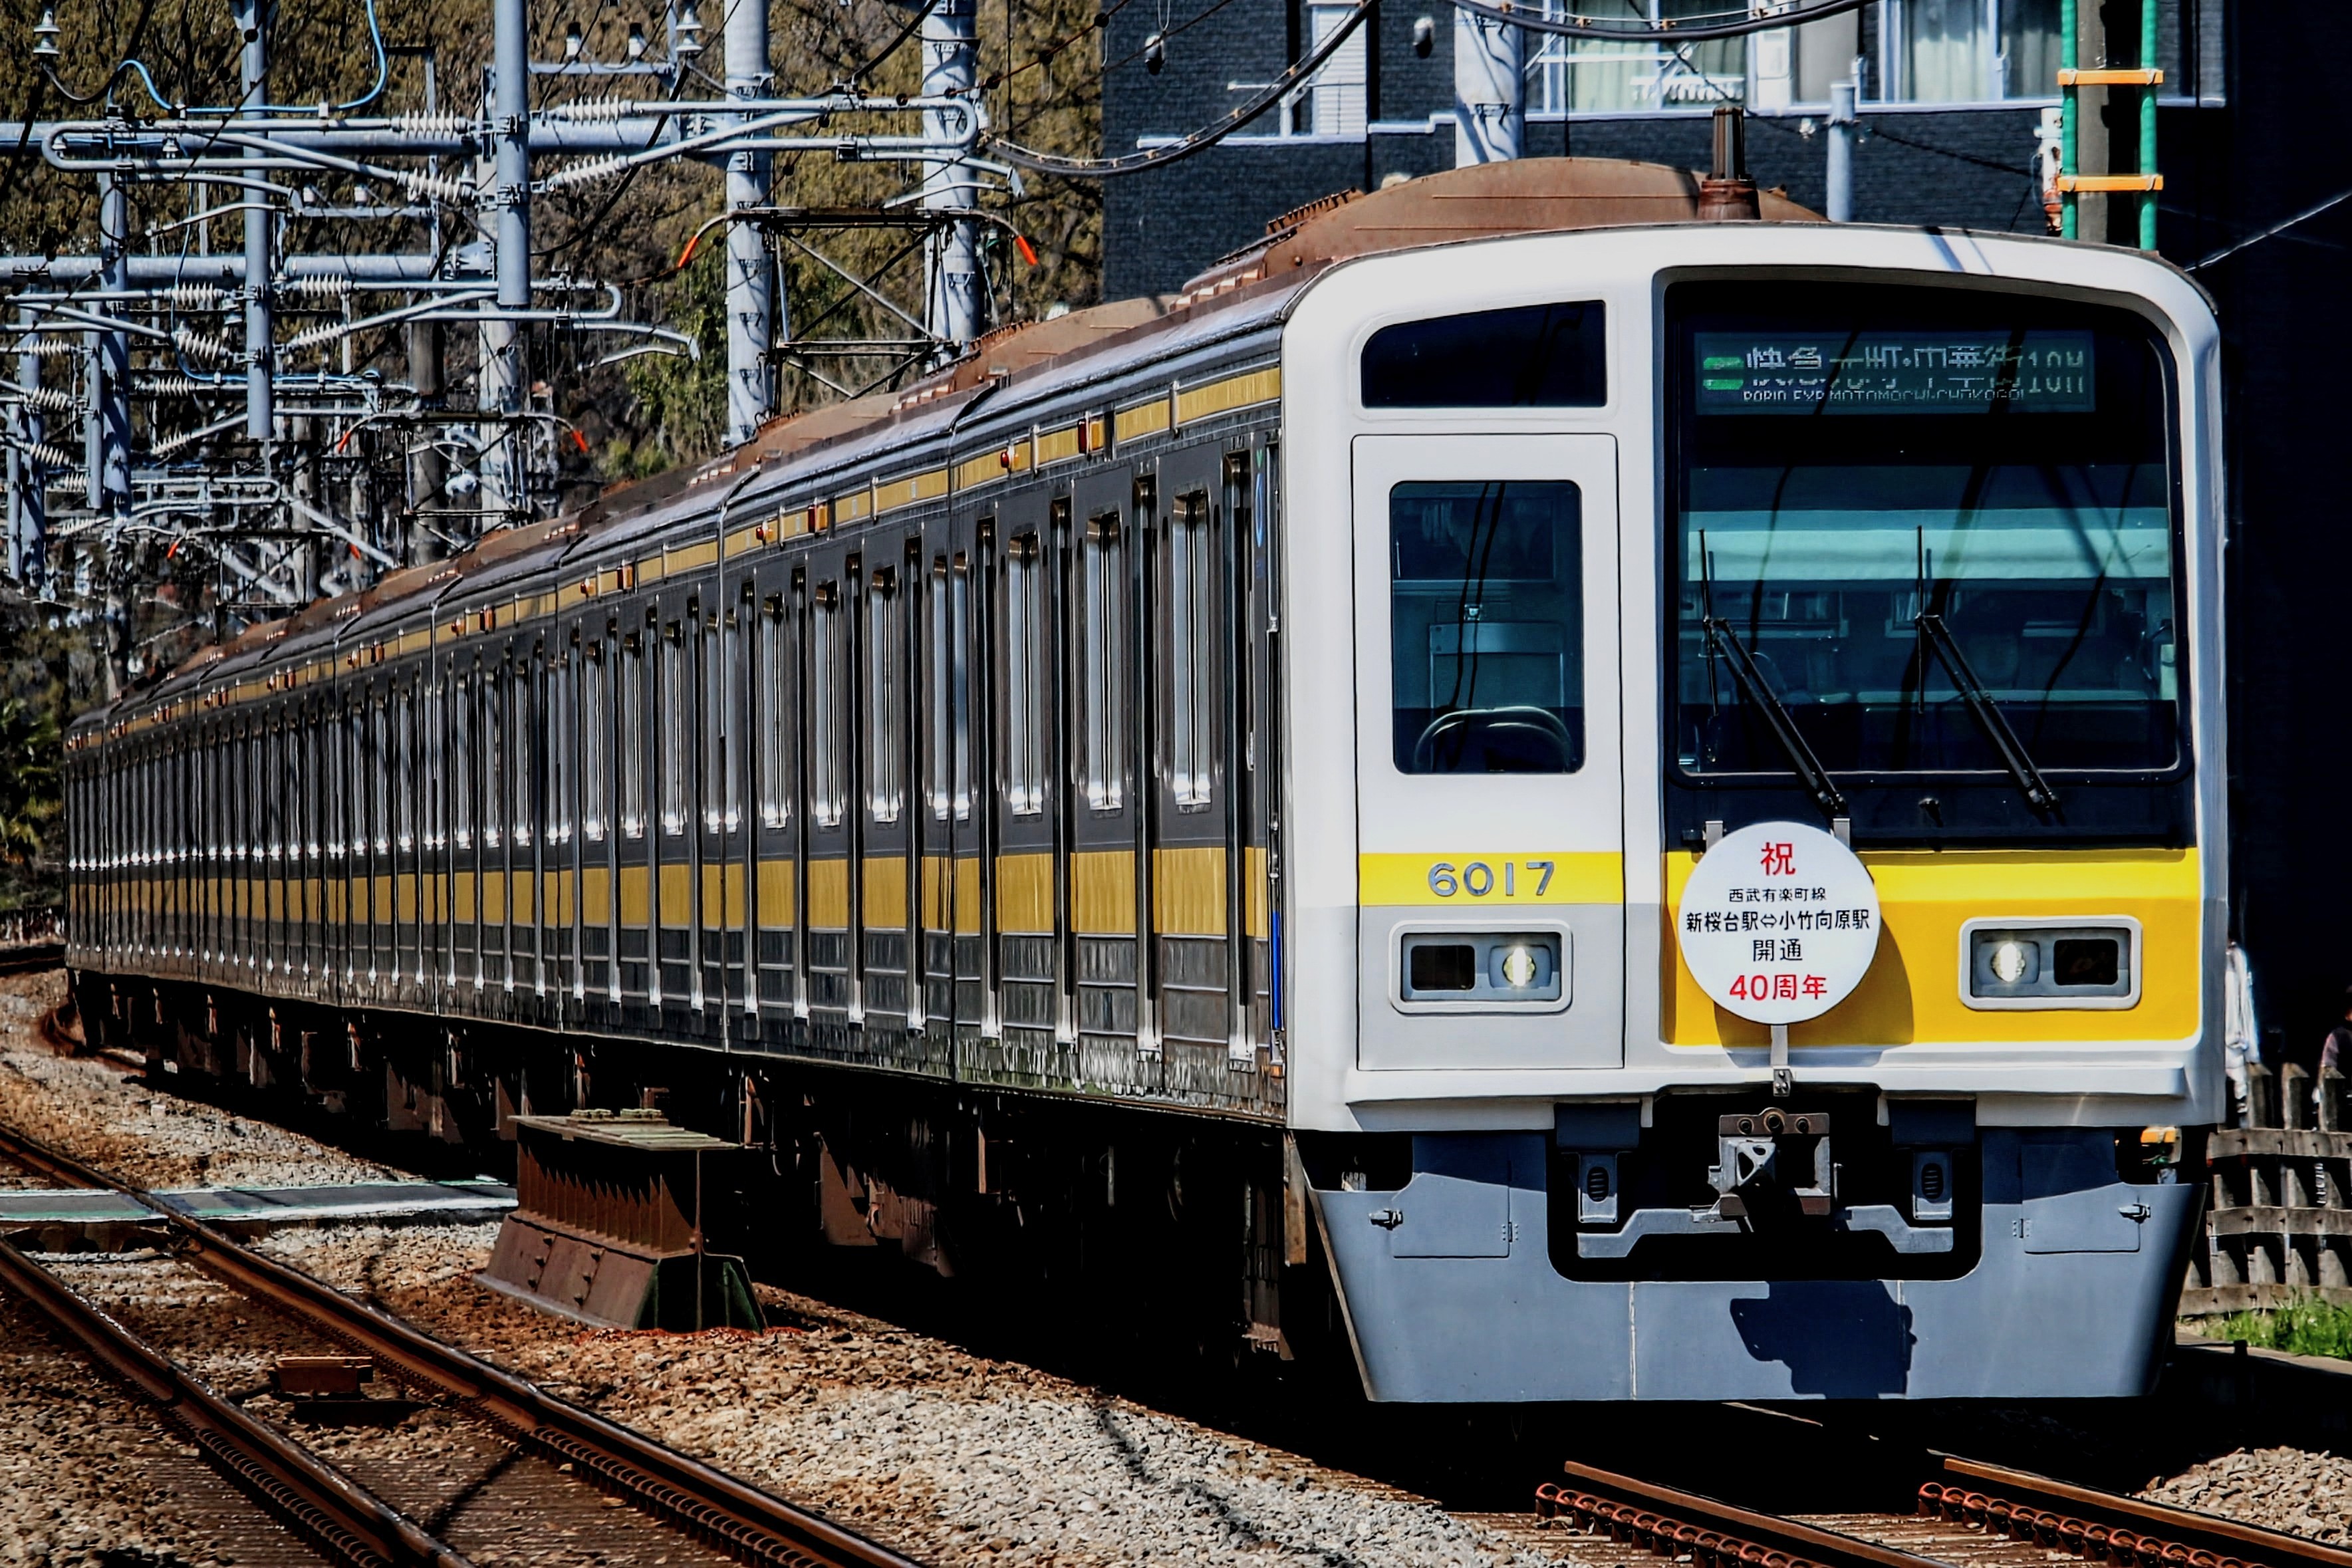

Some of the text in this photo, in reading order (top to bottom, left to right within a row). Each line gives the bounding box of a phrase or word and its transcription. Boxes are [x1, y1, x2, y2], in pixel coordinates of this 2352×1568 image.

[1760, 841, 1795, 876] 祝
[1428, 861, 1555, 897] 6017
[1729, 886, 1827, 903] 西武有楽町線
[1753, 938, 1803, 962] 開通
[1729, 974, 1828, 1001] 40周年
